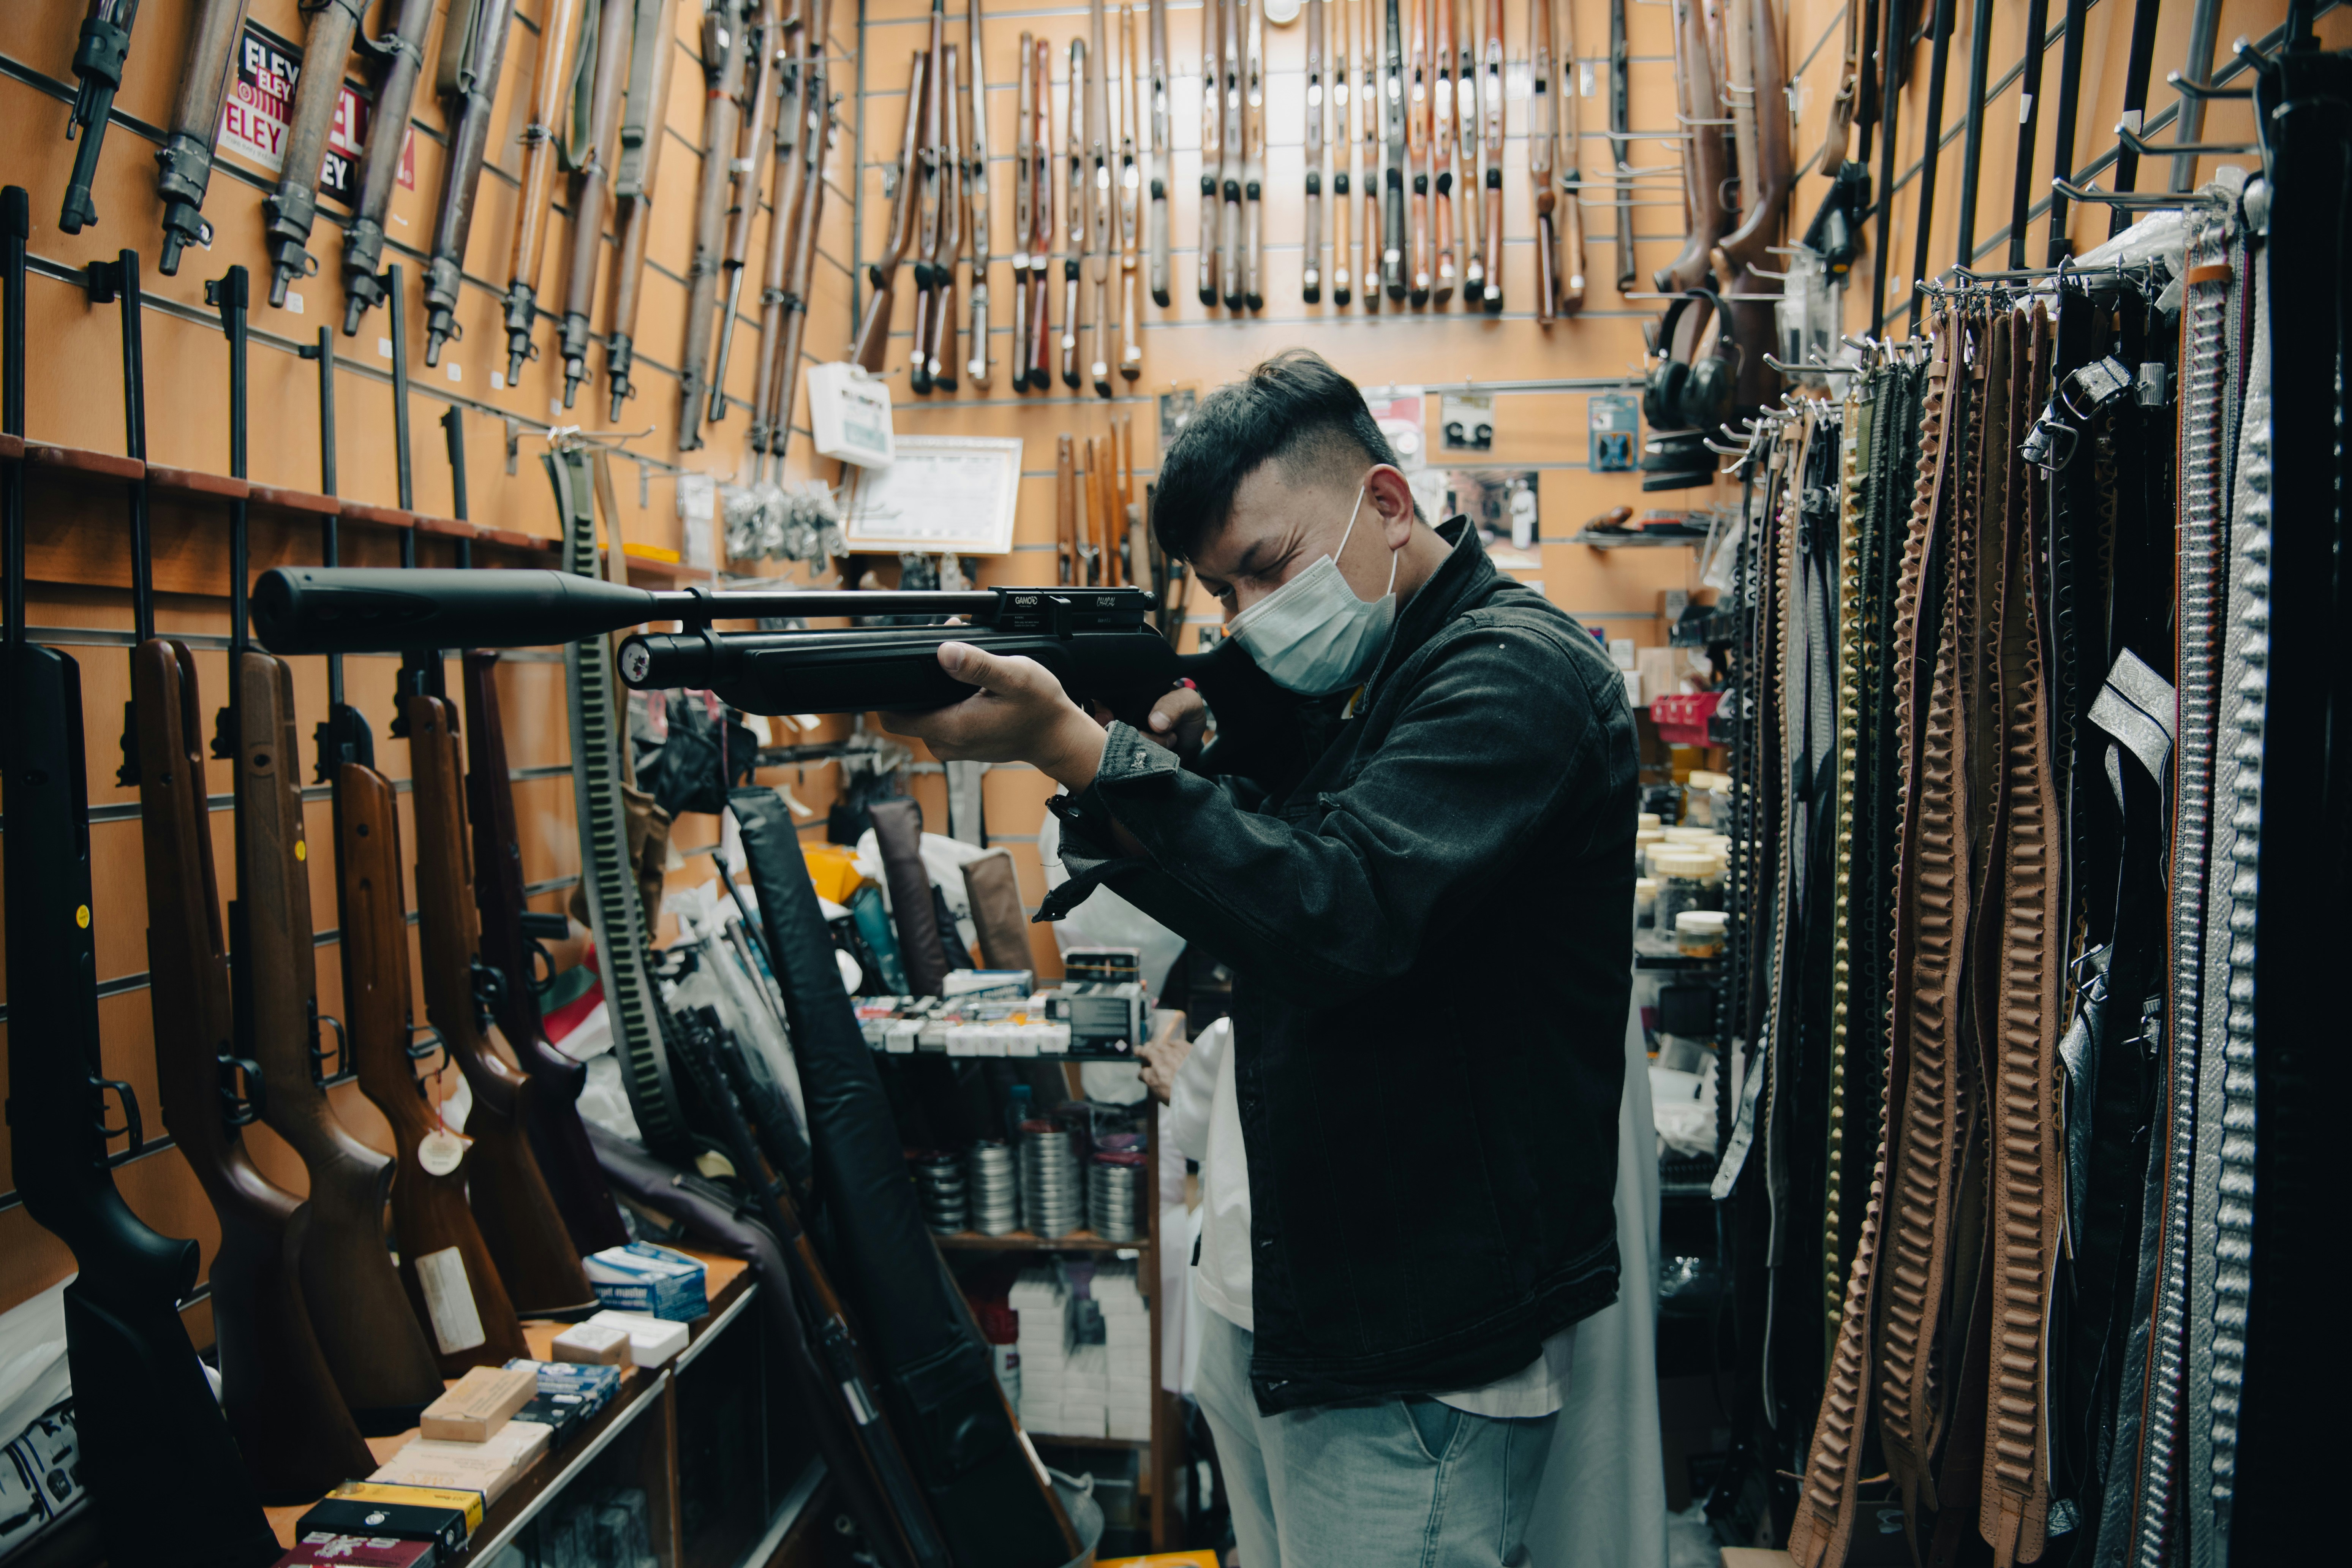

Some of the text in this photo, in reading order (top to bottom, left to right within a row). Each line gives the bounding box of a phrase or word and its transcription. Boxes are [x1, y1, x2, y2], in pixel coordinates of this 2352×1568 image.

[258, 68, 291, 102] ELEY
[226, 101, 281, 155] ELEY
[320, 152, 347, 190] EY
[1097, 596, 1115, 607] CHACAL
